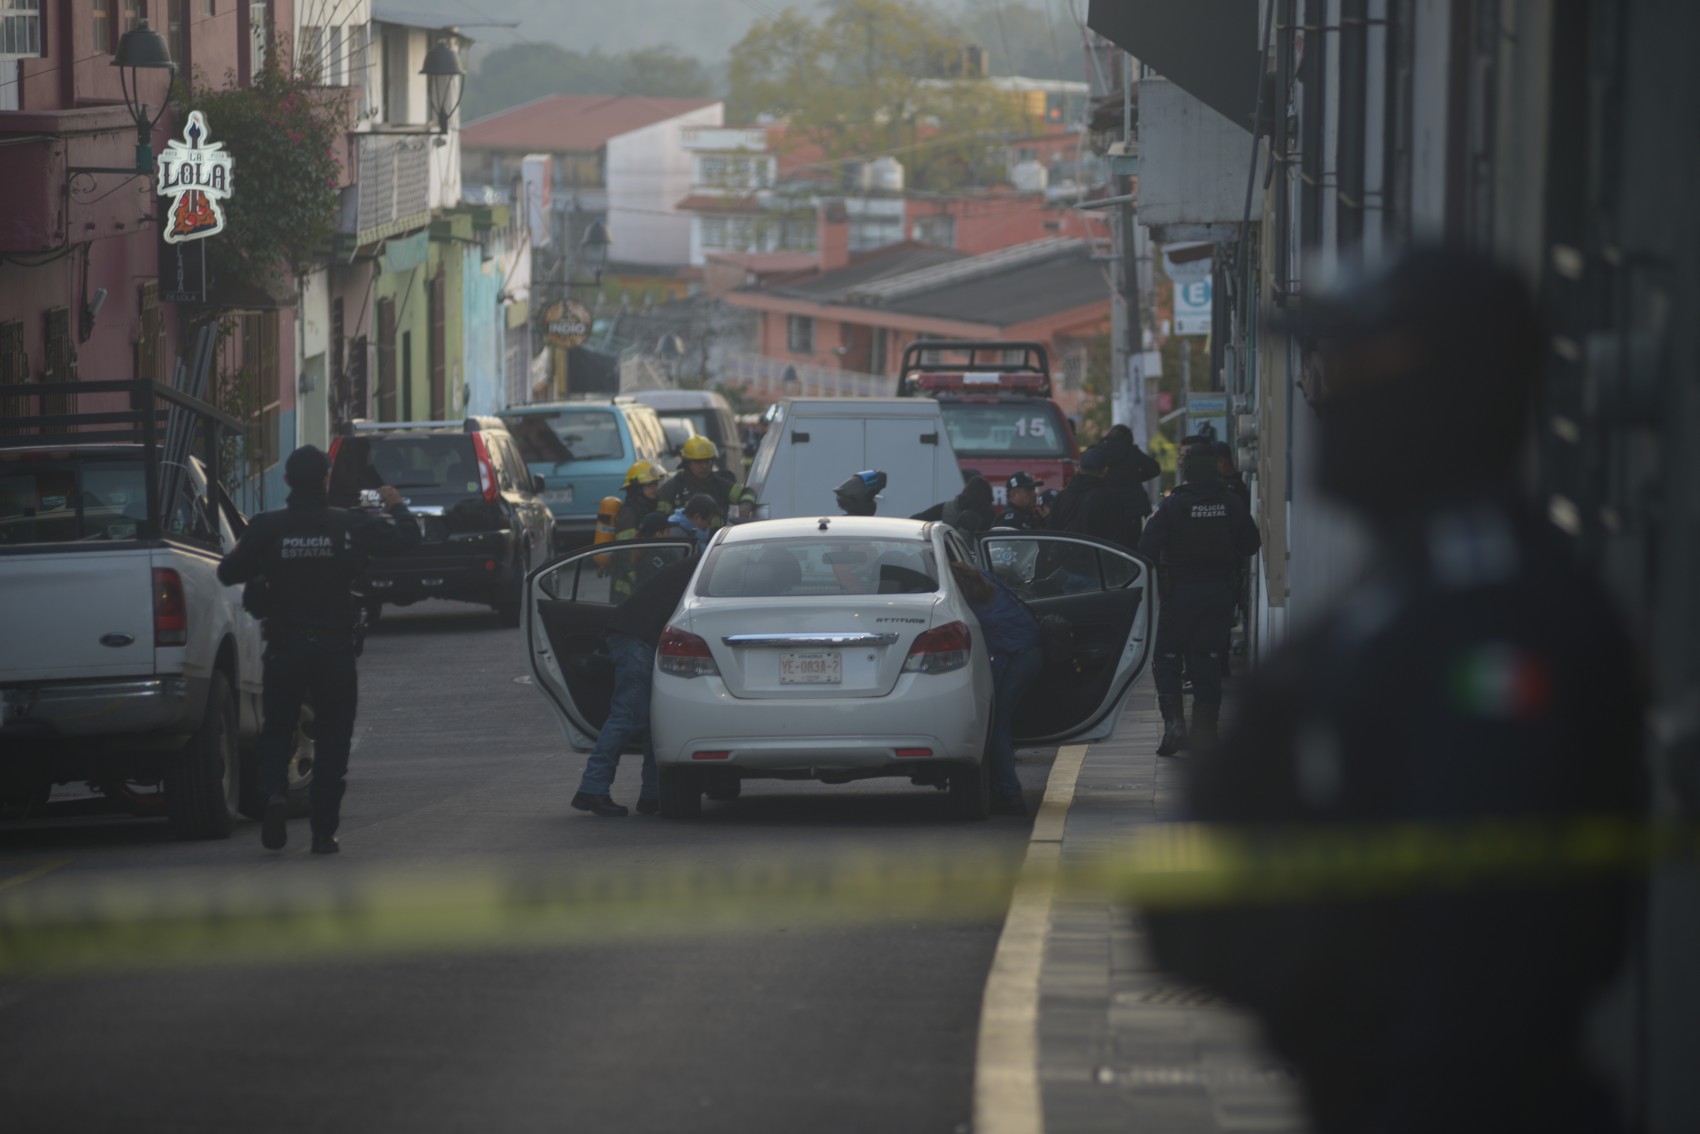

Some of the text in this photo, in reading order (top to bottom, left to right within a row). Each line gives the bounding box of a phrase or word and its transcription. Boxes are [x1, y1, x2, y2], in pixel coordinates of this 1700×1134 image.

[189, 152, 202, 162] LA
[162, 162, 225, 191] LOLA
[548, 323, 586, 336] INDIO
[1015, 418, 1046, 437] 15
[281, 548, 335, 558] ESTATAL
